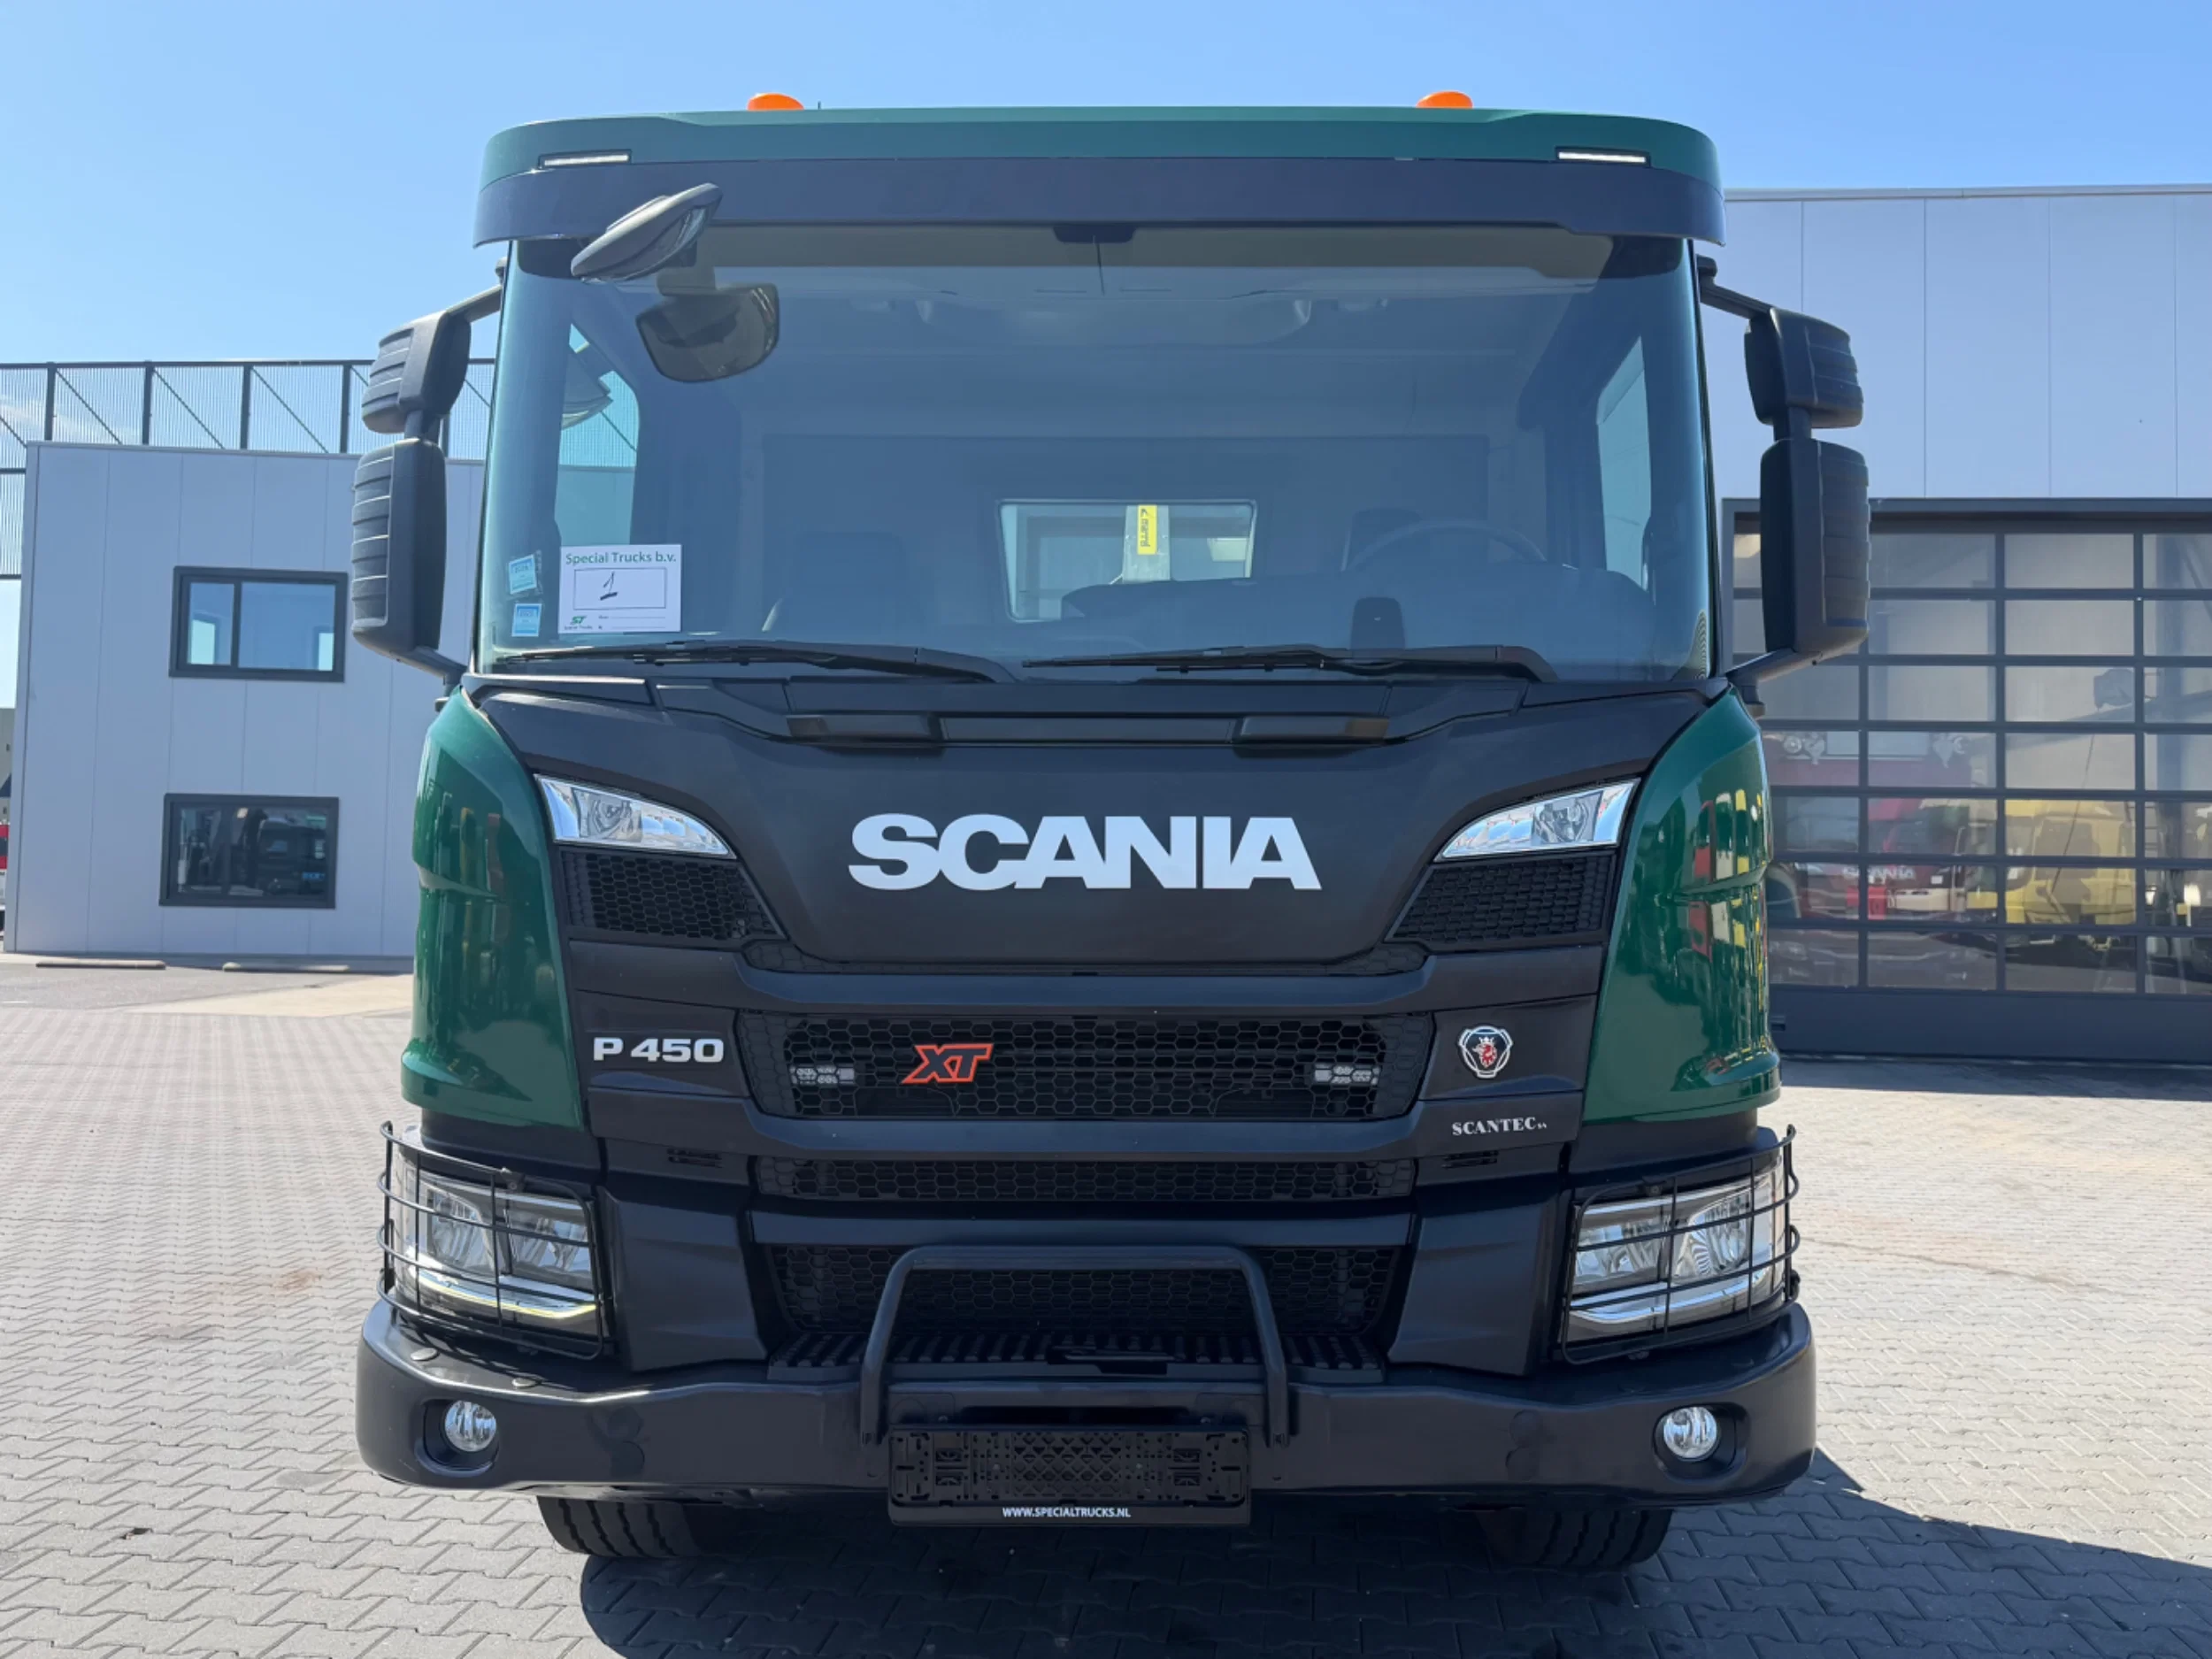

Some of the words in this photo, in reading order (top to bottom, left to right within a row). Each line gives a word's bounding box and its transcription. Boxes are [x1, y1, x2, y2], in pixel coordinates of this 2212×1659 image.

[565, 552, 609, 565] Special
[611, 551, 652, 563] Trucks
[656, 551, 677, 563] b.v.
[849, 813, 1322, 891] SCANIA
[594, 1037, 623, 1061] P
[630, 1038, 724, 1063] 450
[902, 1043, 994, 1085] XT
[1451, 1117, 1536, 1135] SCANTEC
[1002, 1507, 1131, 1517] WWW.SPECIALTRUCKS.NL
